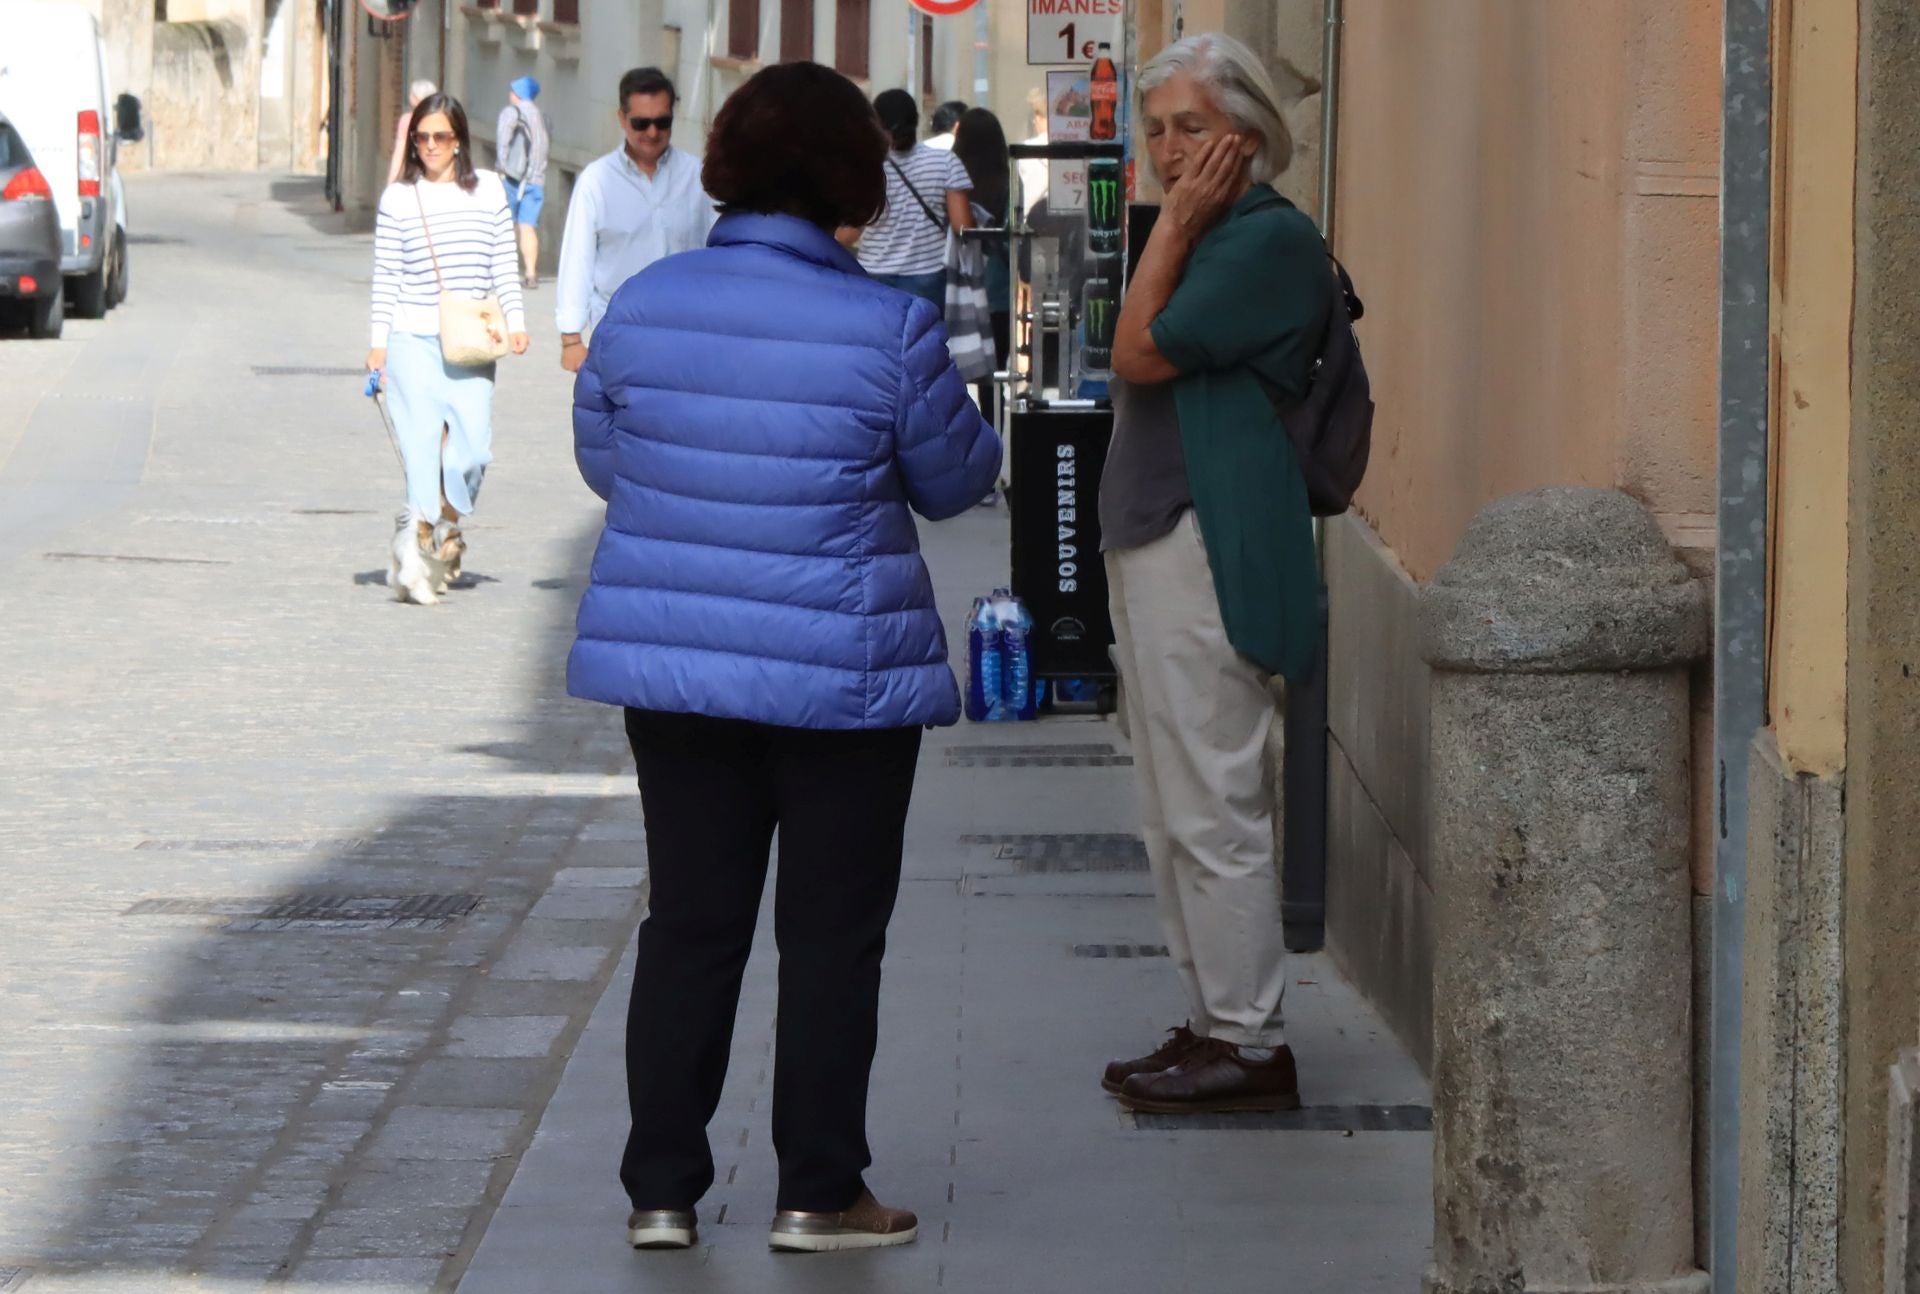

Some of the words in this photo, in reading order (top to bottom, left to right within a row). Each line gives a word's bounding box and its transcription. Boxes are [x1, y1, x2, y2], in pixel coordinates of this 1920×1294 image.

[1032, 0, 1121, 14] IMANES
[1066, 120, 1089, 130] ABA
[1056, 444, 1078, 593] SOUVENIRS
